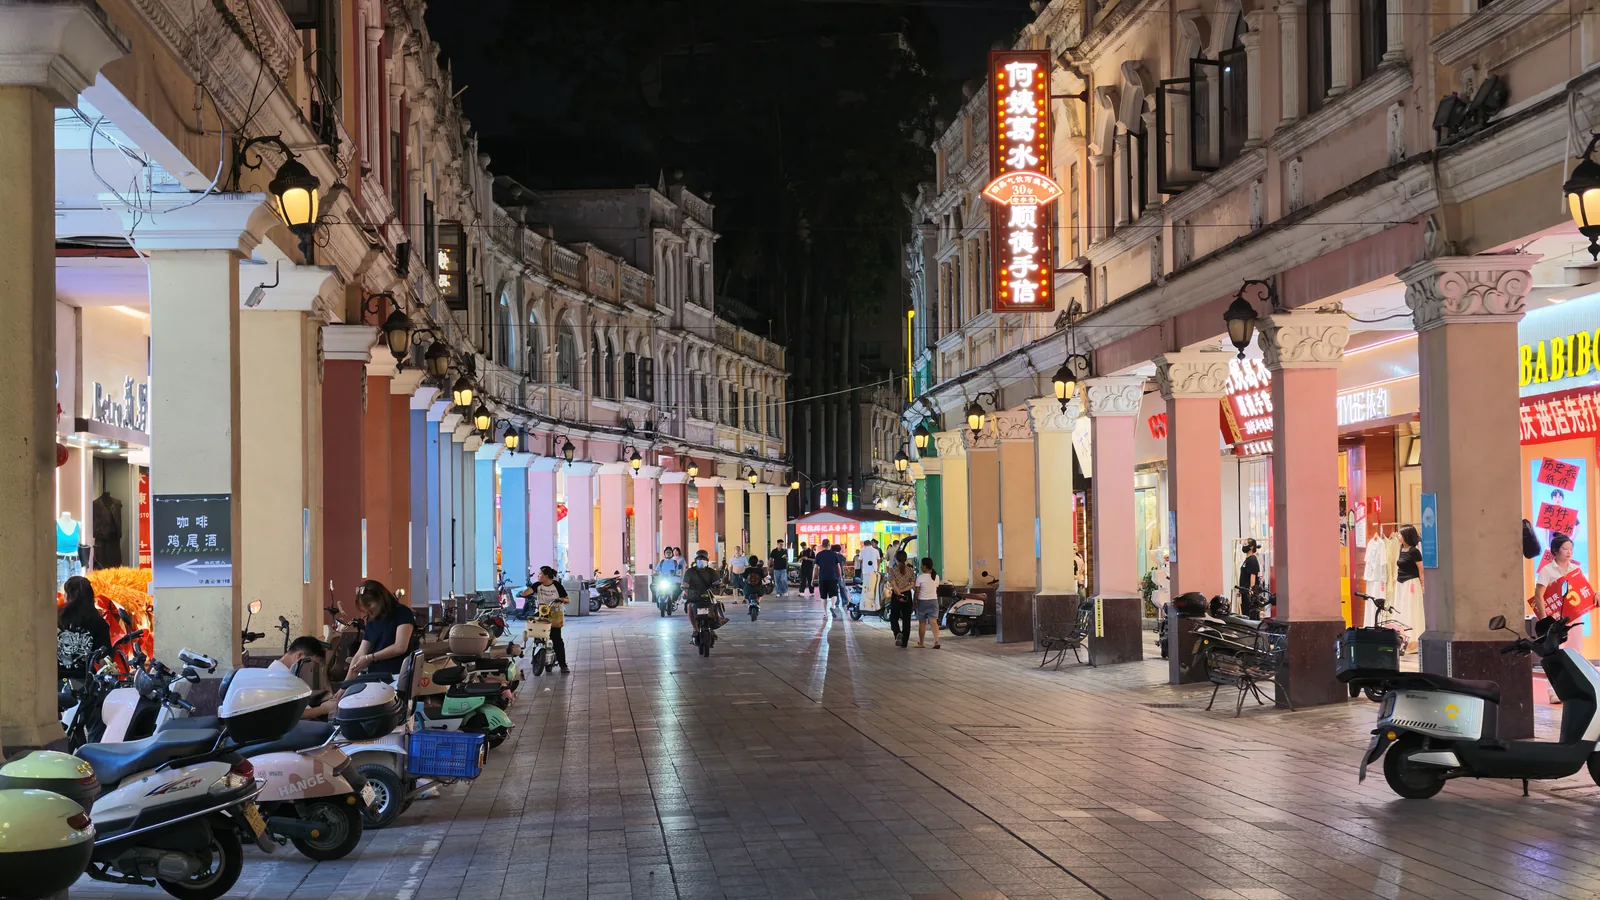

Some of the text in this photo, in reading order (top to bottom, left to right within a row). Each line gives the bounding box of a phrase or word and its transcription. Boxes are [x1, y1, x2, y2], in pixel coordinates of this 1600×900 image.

[1005, 60, 1038, 170] 何姨葛水
[1007, 205, 1039, 304] 顺德手信
[1543, 505, 1569, 520] 两件
[176, 515, 208, 528] 咖啡
[1543, 516, 1574, 533] 3.5折
[167, 533, 217, 548] 鸡尾酒
[277, 772, 325, 798] HANGE
